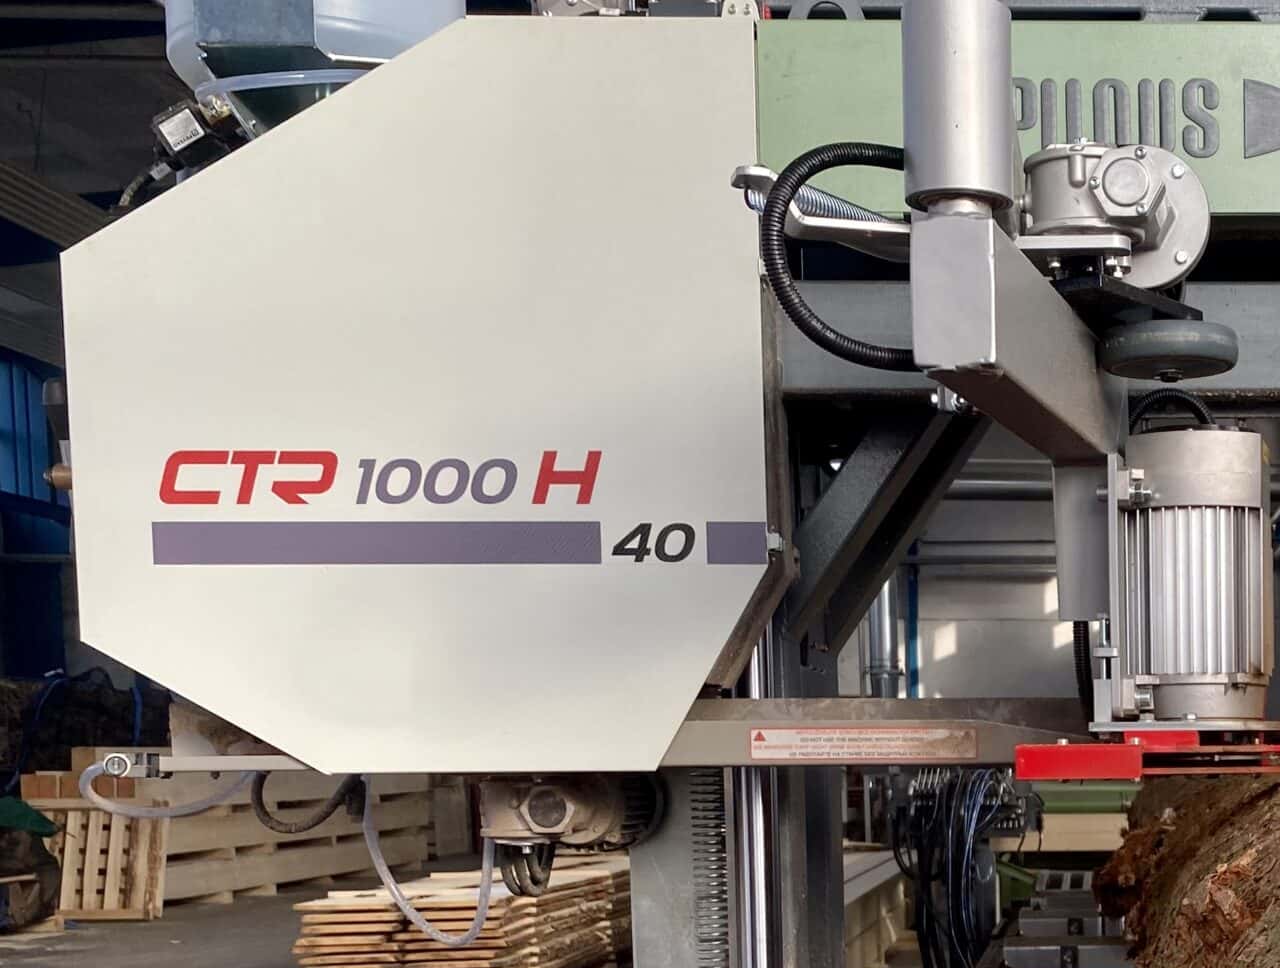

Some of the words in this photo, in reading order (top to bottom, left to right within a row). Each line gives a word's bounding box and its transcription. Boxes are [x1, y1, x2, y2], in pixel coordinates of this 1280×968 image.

[158, 450, 338, 505] CTR
[356, 458, 518, 505] 1000
[532, 450, 602, 505] H
[611, 522, 696, 563] 40
